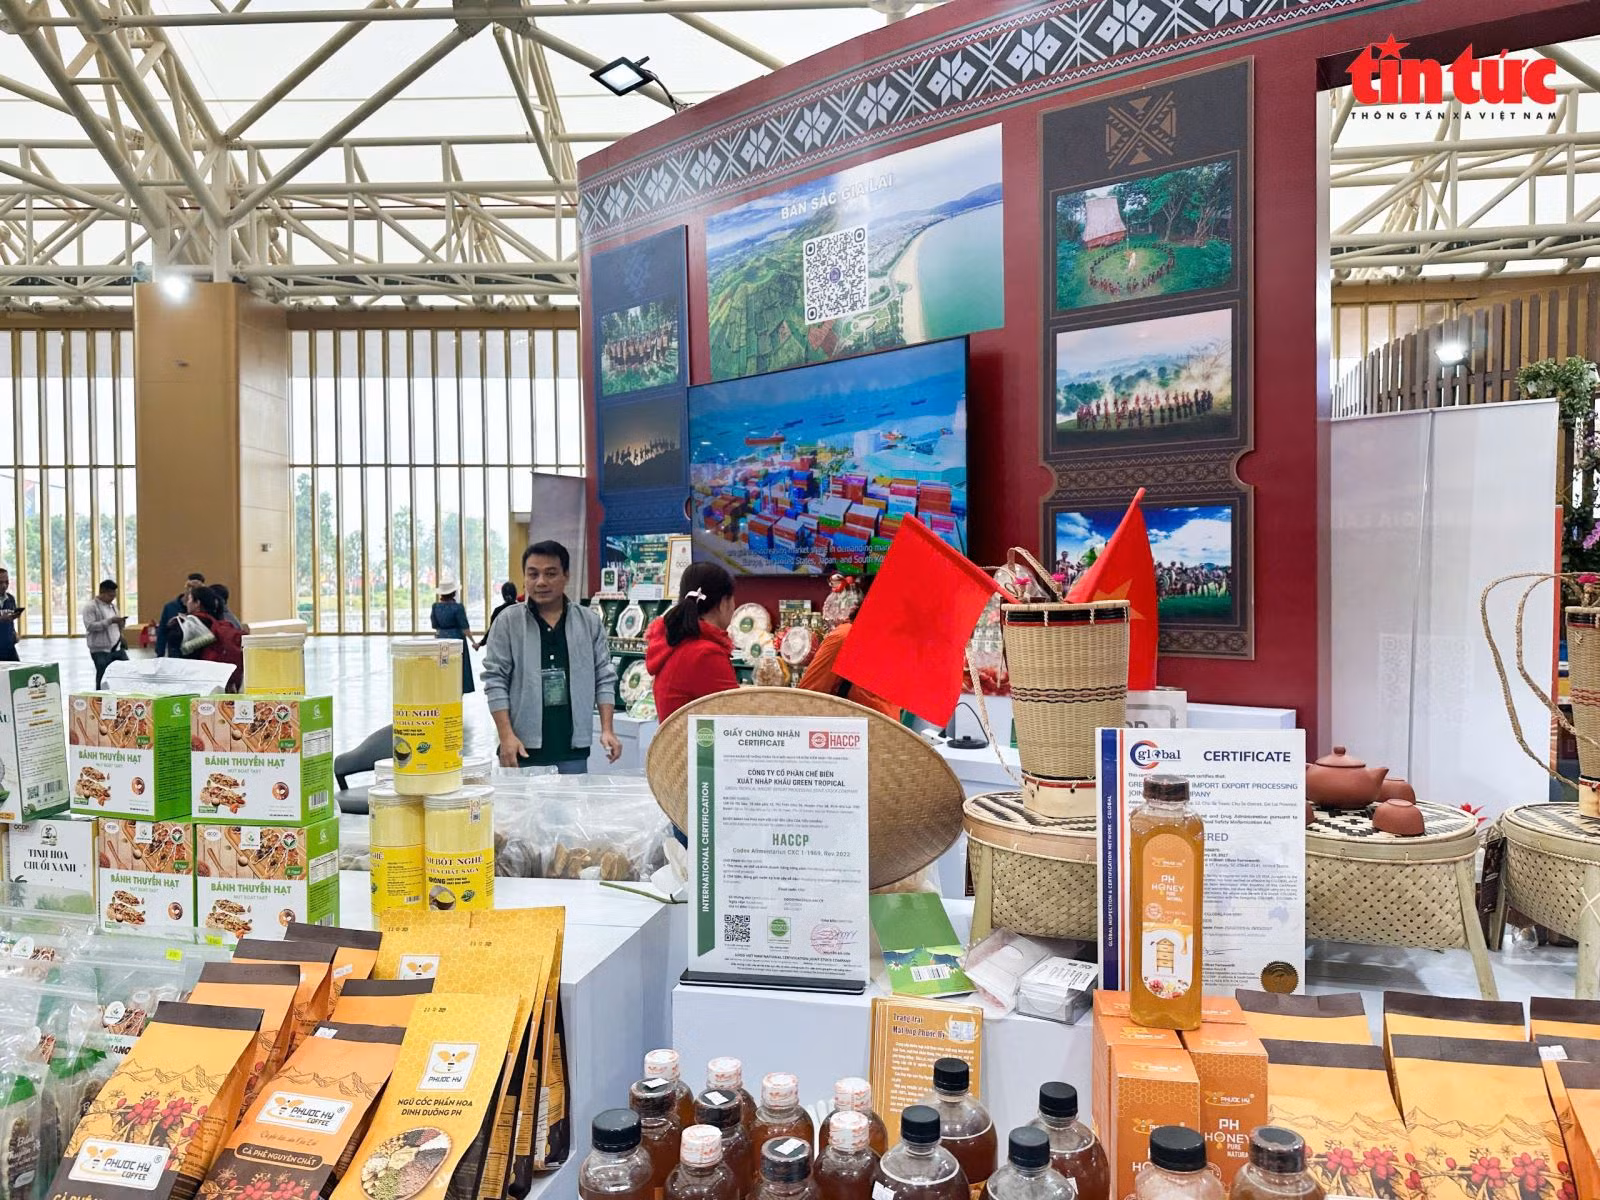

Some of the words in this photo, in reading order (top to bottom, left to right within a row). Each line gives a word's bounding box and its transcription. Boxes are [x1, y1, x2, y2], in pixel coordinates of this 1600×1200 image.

[841, 185, 865, 200] GIA
[870, 173, 894, 191] LAI
[723, 728, 743, 738] GIẤY
[745, 729, 775, 738] CHỨNG
[777, 730, 800, 739] NHẬN
[830, 734, 860, 747] HACCP
[79, 749, 97, 760] BÁNH
[127, 754, 141, 765] HẠT
[1138, 749, 1181, 760] global
[1203, 751, 1291, 762] CERTIFICATE
[205, 755, 229, 766] BÁNH
[267, 759, 285, 769] HẠT
[772, 833, 809, 847] HACCP
[28, 849, 51, 859] TINH
[52, 850, 69, 860] HOA
[23, 859, 50, 871] CHUỐI
[51, 862, 76, 872] XANH
[110, 874, 131, 884] BÁNH
[163, 879, 179, 889] HẠT
[702, 847, 710, 912] INTERNATIONAL
[1161, 874, 1175, 883] PH
[211, 881, 235, 892] BÁNH
[274, 885, 291, 896] HẠT
[1151, 883, 1184, 892] HONEY
[415, 1096, 432, 1106] CỐC
[456, 1099, 473, 1107] HOA
[306, 1117, 330, 1127] COFFEE
[1219, 1119, 1240, 1130] PH
[242, 1147, 252, 1155] CÀ
[253, 1149, 268, 1159] PHÊ
[268, 1152, 297, 1163] NGUYÊN
[121, 1171, 147, 1180] COFFEE
